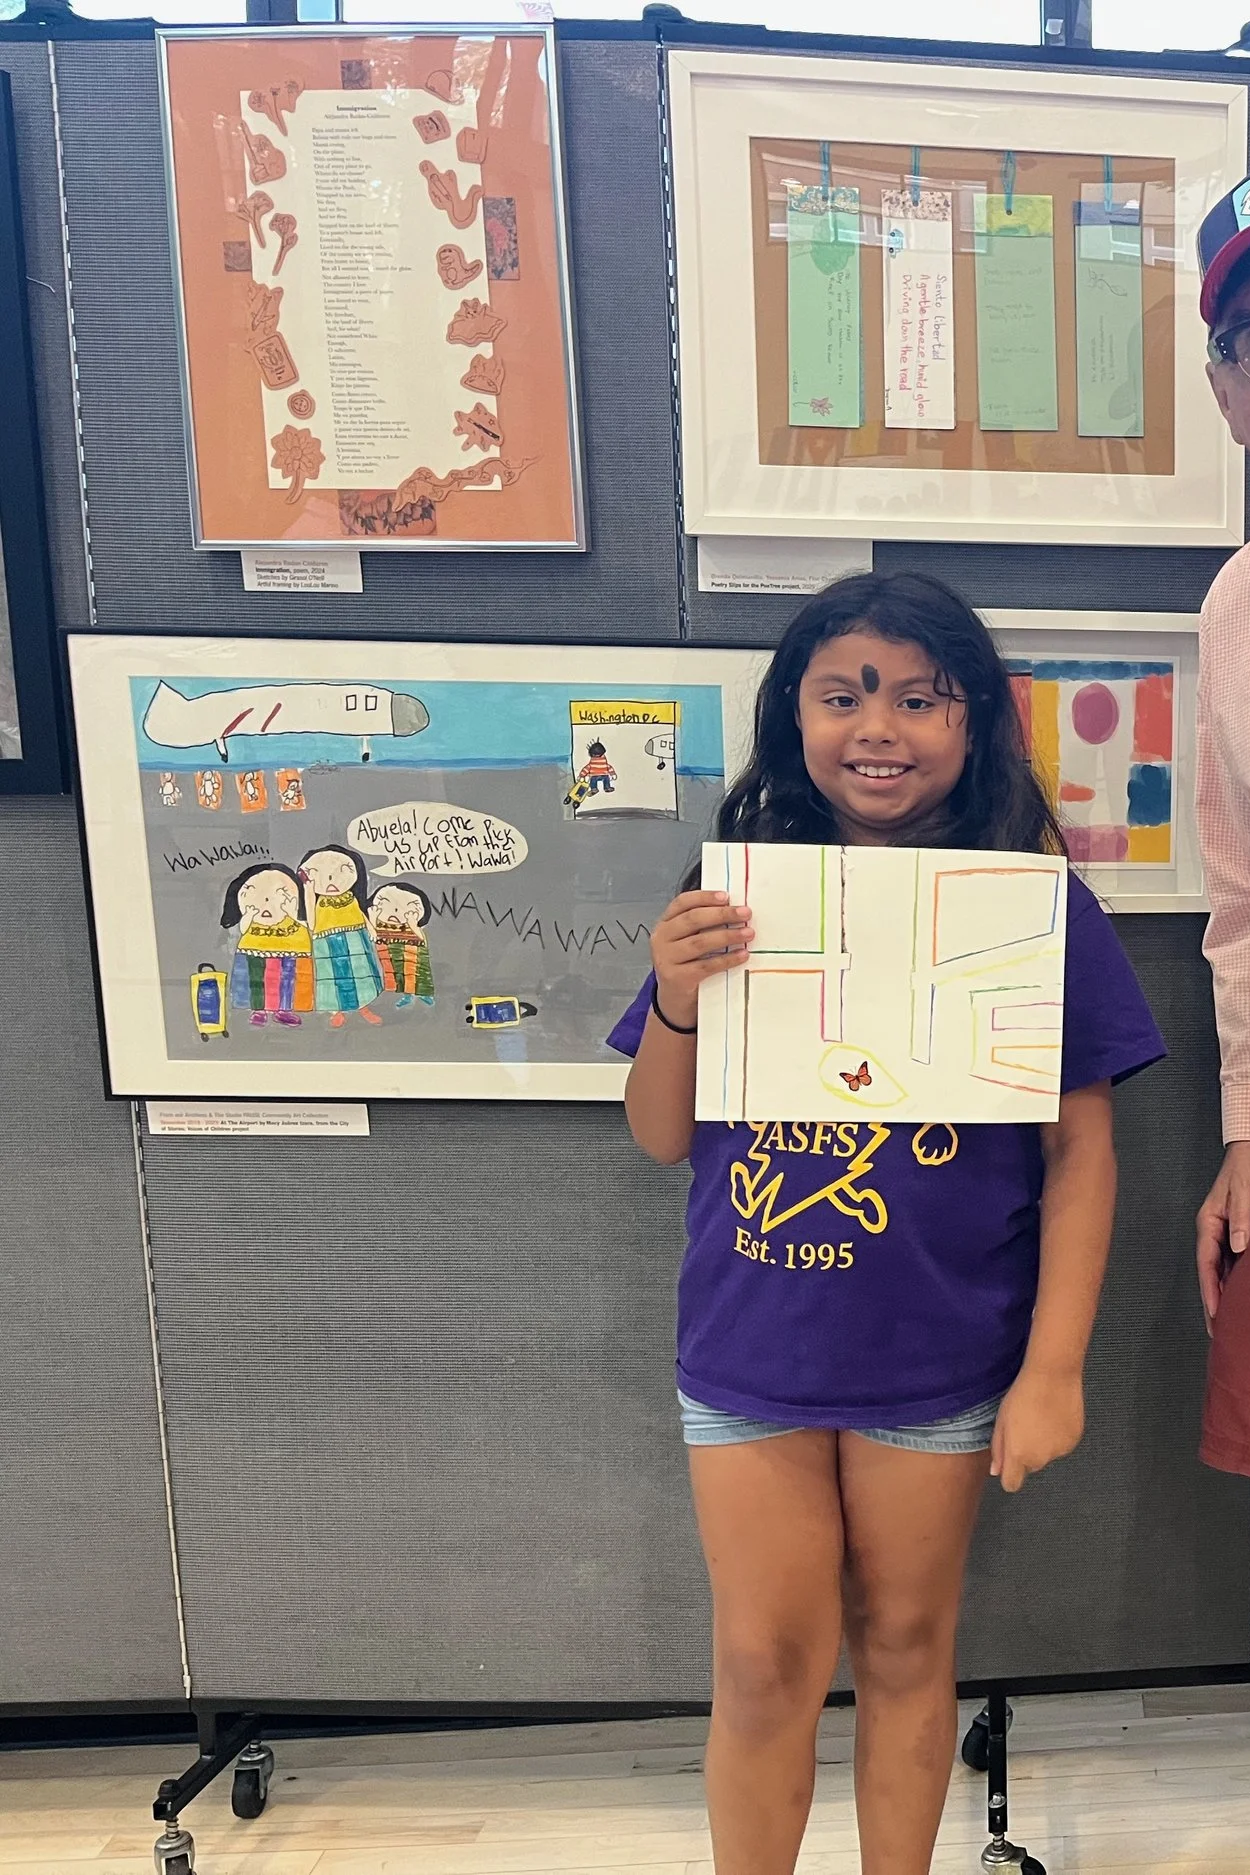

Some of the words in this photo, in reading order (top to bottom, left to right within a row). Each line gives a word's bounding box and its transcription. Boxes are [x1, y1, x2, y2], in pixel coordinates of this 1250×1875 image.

[897, 273, 913, 315] Driving
[935, 273, 948, 308] Siento
[900, 346, 913, 364] the
[932, 315, 946, 361] libertad
[899, 368, 912, 391] road
[762, 1120, 860, 1158] ASFS
[734, 1225, 778, 1265] Est.
[784, 1241, 854, 1271] 1995
